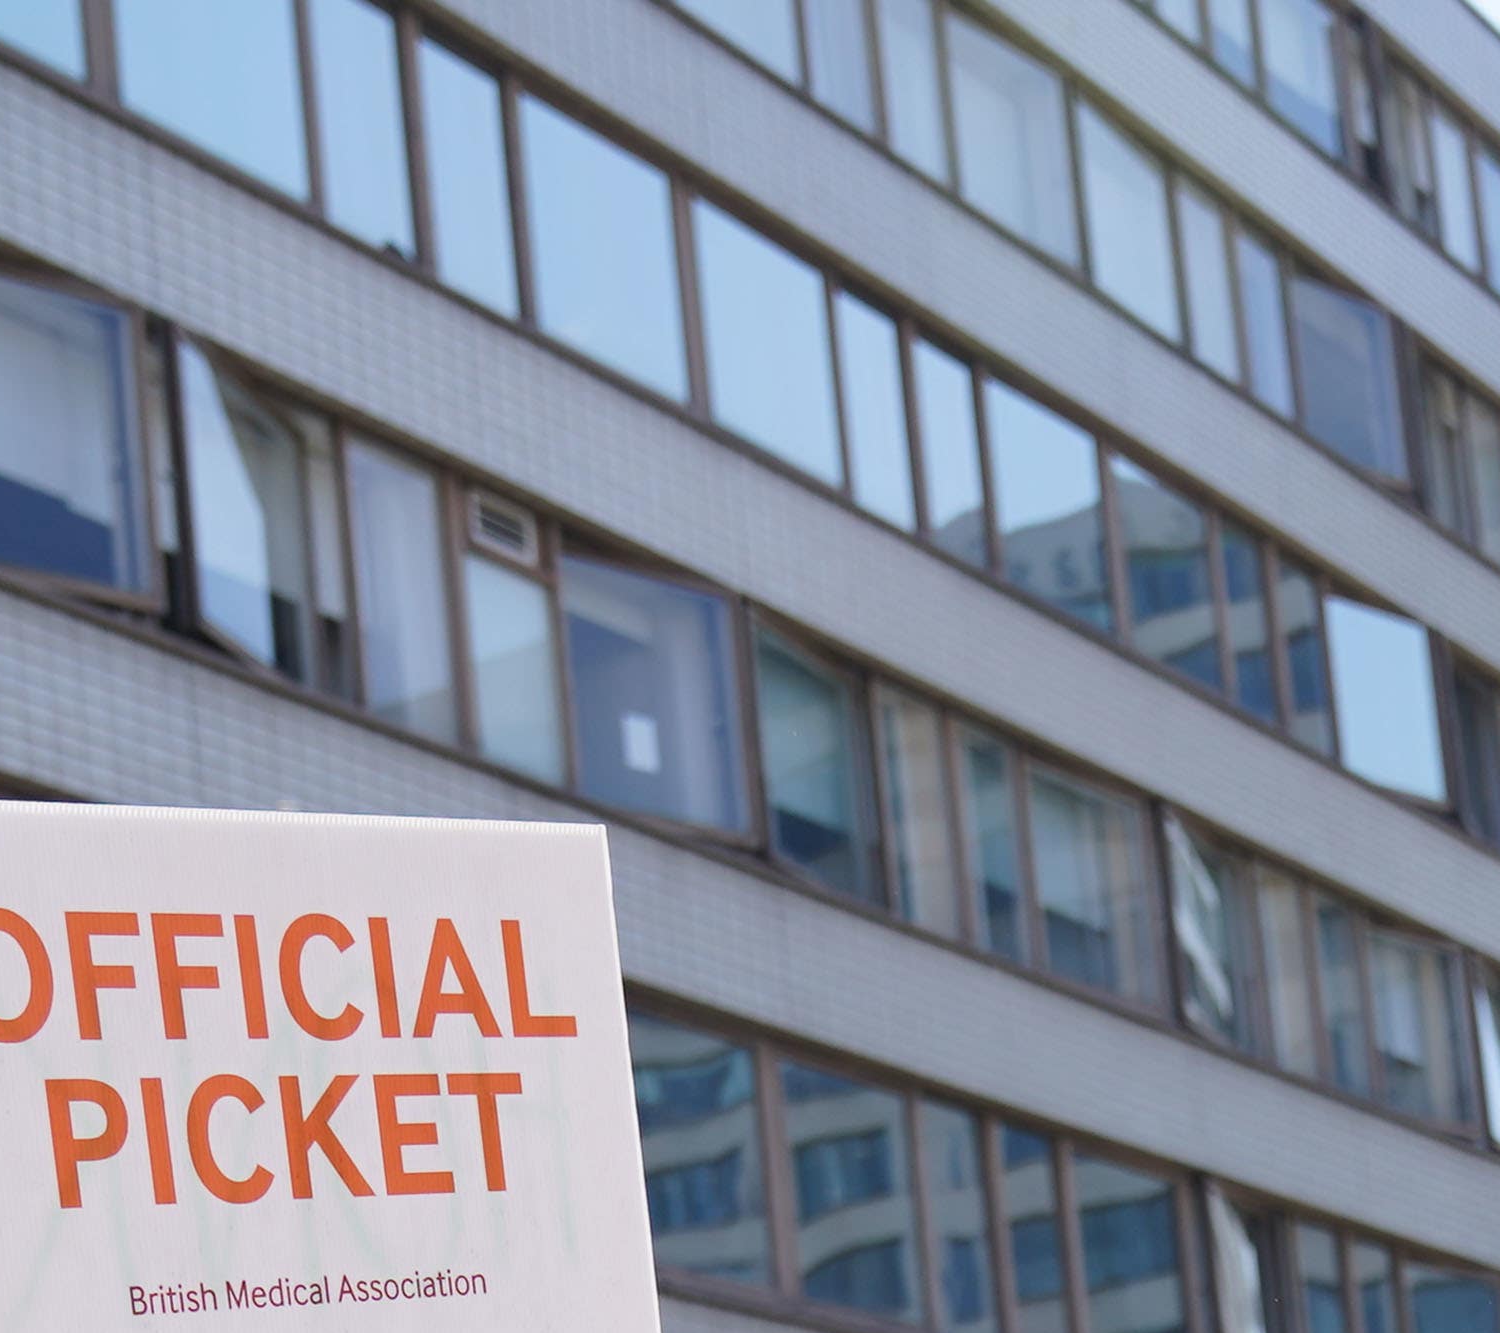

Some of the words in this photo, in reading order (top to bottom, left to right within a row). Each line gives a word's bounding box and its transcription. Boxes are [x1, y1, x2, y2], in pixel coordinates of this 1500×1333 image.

[46, 1074, 521, 1207] PICKET
[130, 1284, 217, 1316] British
[225, 1276, 330, 1310] Medical
[338, 1270, 487, 1303] Association
